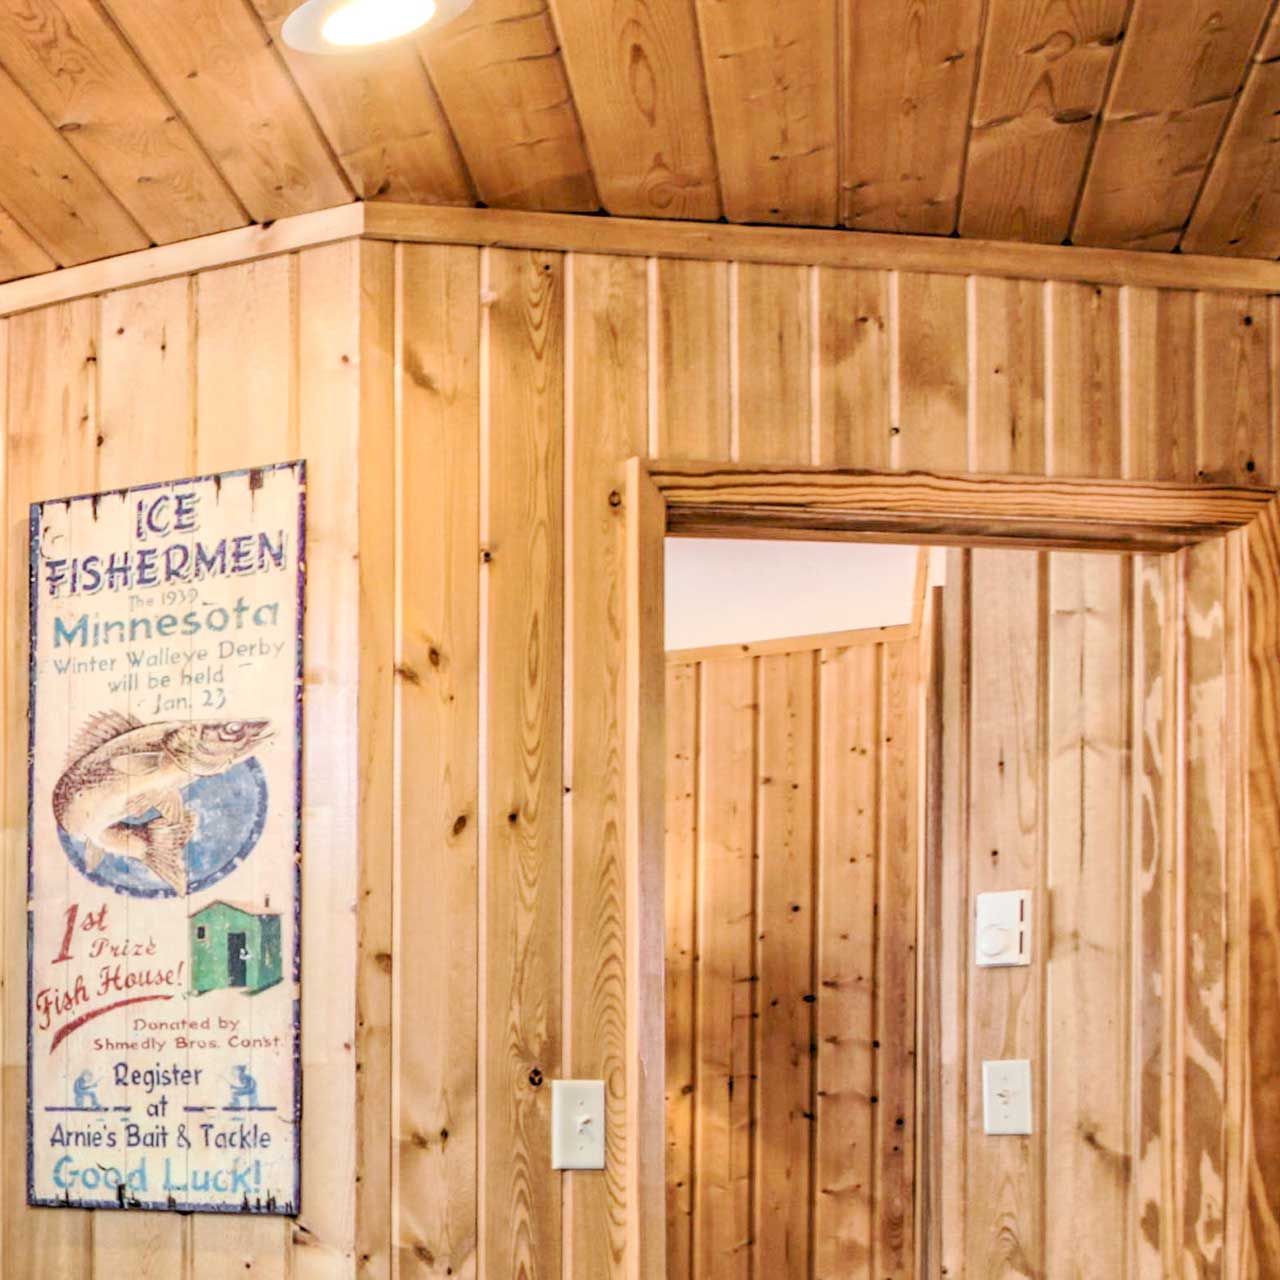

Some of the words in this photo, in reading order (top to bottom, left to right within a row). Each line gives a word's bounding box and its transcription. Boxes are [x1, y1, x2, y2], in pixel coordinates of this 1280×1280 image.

[135, 492, 200, 541] ICE
[45, 529, 288, 597] FISHERMEN
[53, 597, 279, 648] Minnesota
[53, 656, 117, 676] Winter
[125, 645, 209, 670] Walleye
[217, 637, 287, 662] Derby
[107, 673, 140, 695] will
[147, 673, 172, 690] be
[180, 665, 226, 687] held
[152, 694, 193, 716] Jan.
[202, 688, 228, 710] 23
[51, 904, 108, 965] 1st
[88, 935, 158, 960] Prize
[35, 976, 90, 1032] Fish
[96, 961, 185, 998] House!
[133, 1018, 211, 1032] Donated
[217, 1016, 240, 1034] by
[93, 1037, 167, 1052] Shmedly
[175, 1036, 222, 1050] Bros.
[113, 1062, 204, 1093] Register
[146, 1095, 169, 1118] at
[50, 1125, 118, 1149] Arnie's
[124, 1123, 169, 1149] Bait
[176, 1123, 192, 1150] &
[199, 1123, 272, 1149] Tackle
[52, 1154, 149, 1193] Good
[162, 1157, 264, 1193] Luck!
